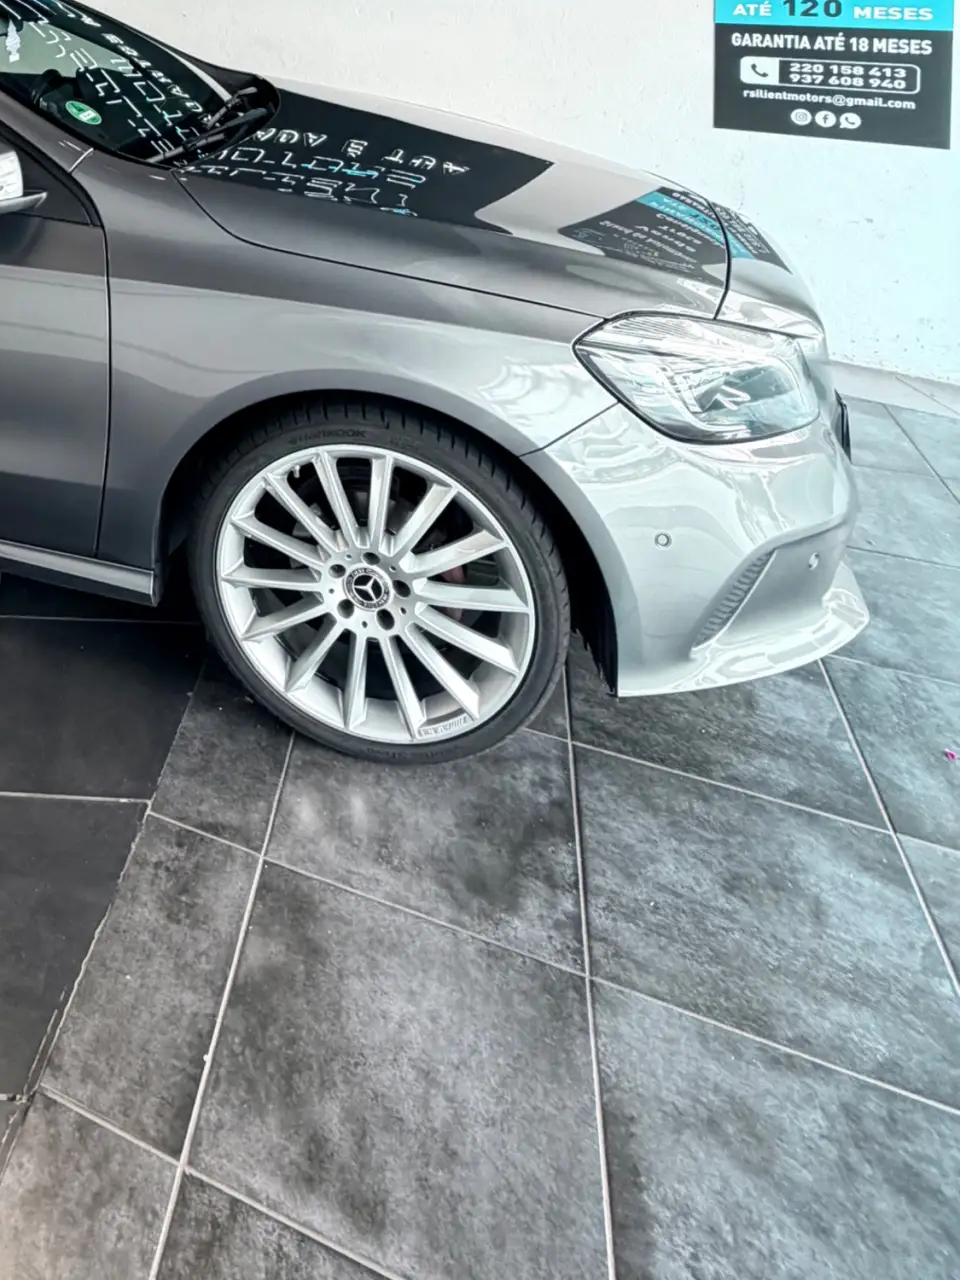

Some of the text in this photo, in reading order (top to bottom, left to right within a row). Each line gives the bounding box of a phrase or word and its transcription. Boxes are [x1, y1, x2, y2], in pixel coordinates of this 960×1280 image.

[732, 0, 773, 17] ATÉ
[853, 6, 934, 21] MESES
[731, 32, 933, 56] GARANTIA ATÉ 18 MESES
[789, 62, 907, 79] 220 158 413
[789, 73, 907, 90] 937 608 940
[743, 89, 917, 110] rsilientmotors@gmail.com
